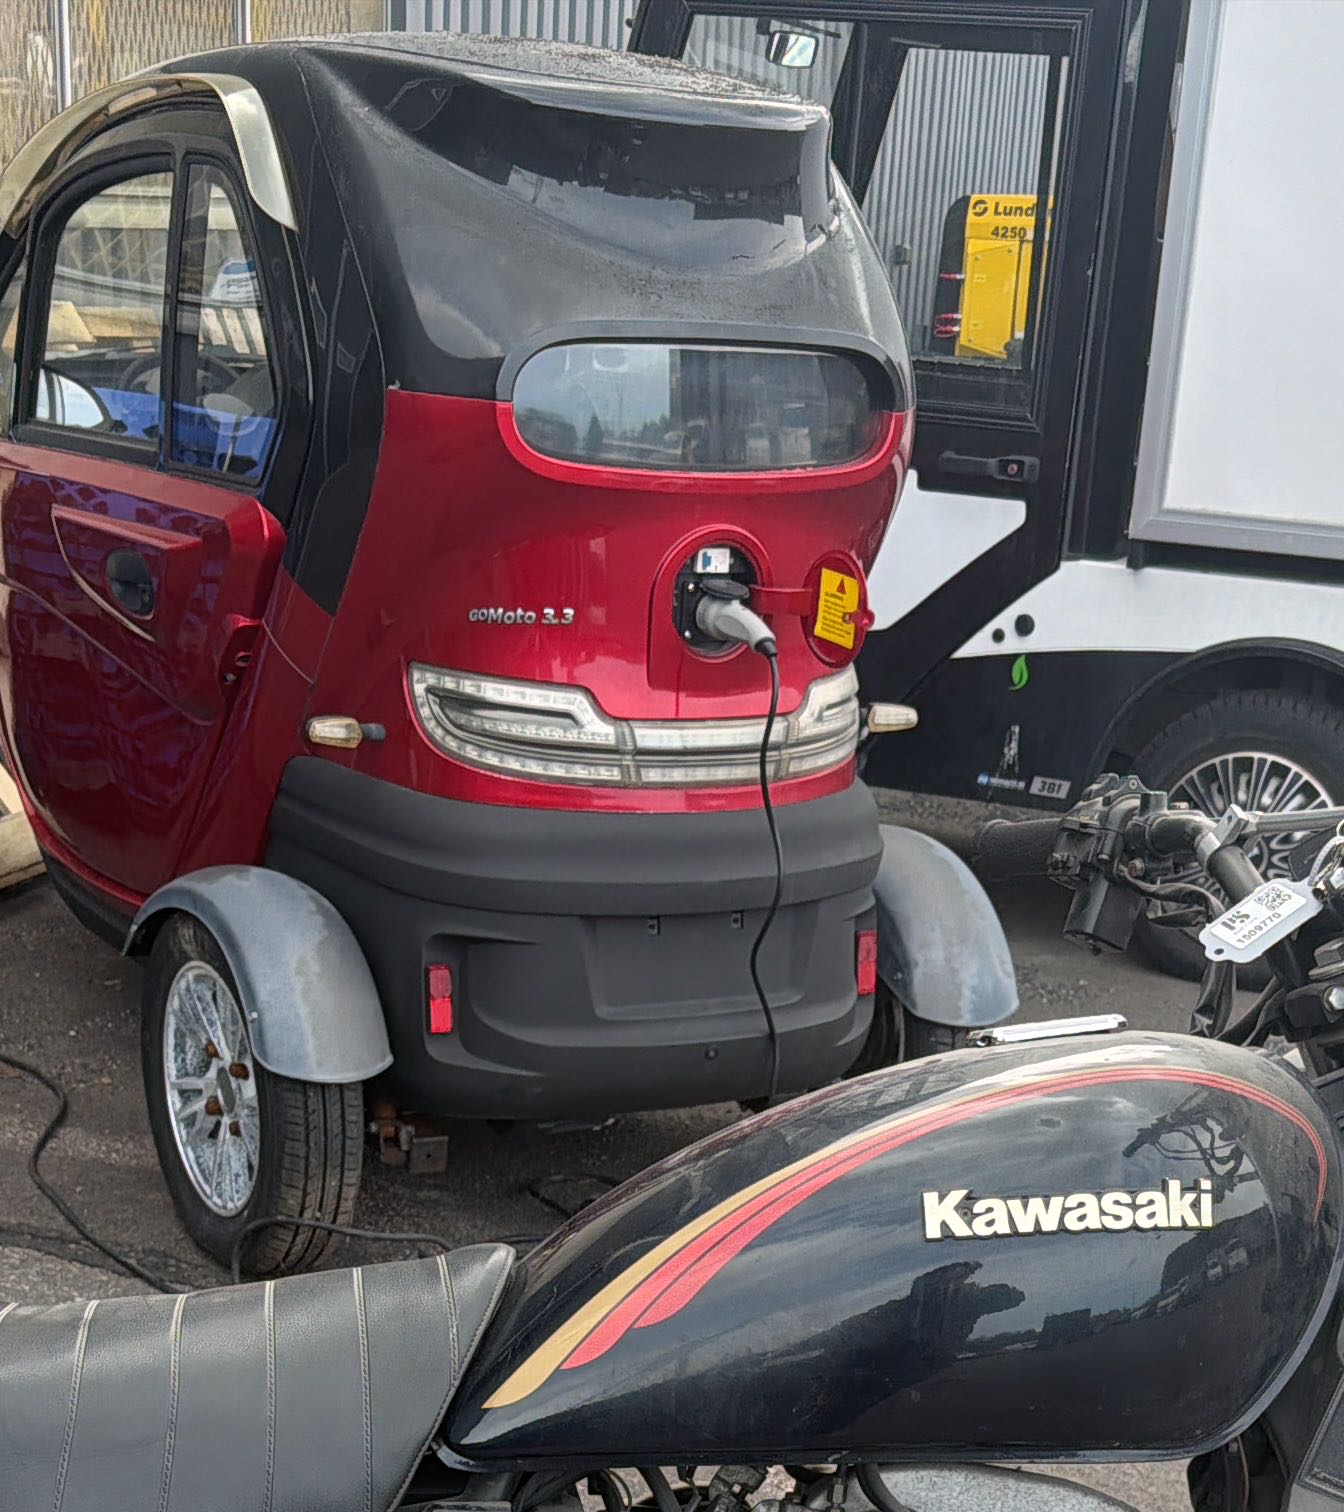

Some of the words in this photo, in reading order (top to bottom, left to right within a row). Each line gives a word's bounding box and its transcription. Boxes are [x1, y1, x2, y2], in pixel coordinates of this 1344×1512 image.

[994, 201, 1035, 217] Lund
[991, 225, 1027, 239] 4250
[541, 607, 574, 624] 3.3
[1038, 781, 1063, 794] 381
[1236, 911, 1281, 944] 1509770
[922, 1178, 1213, 1240] Kawasaki
